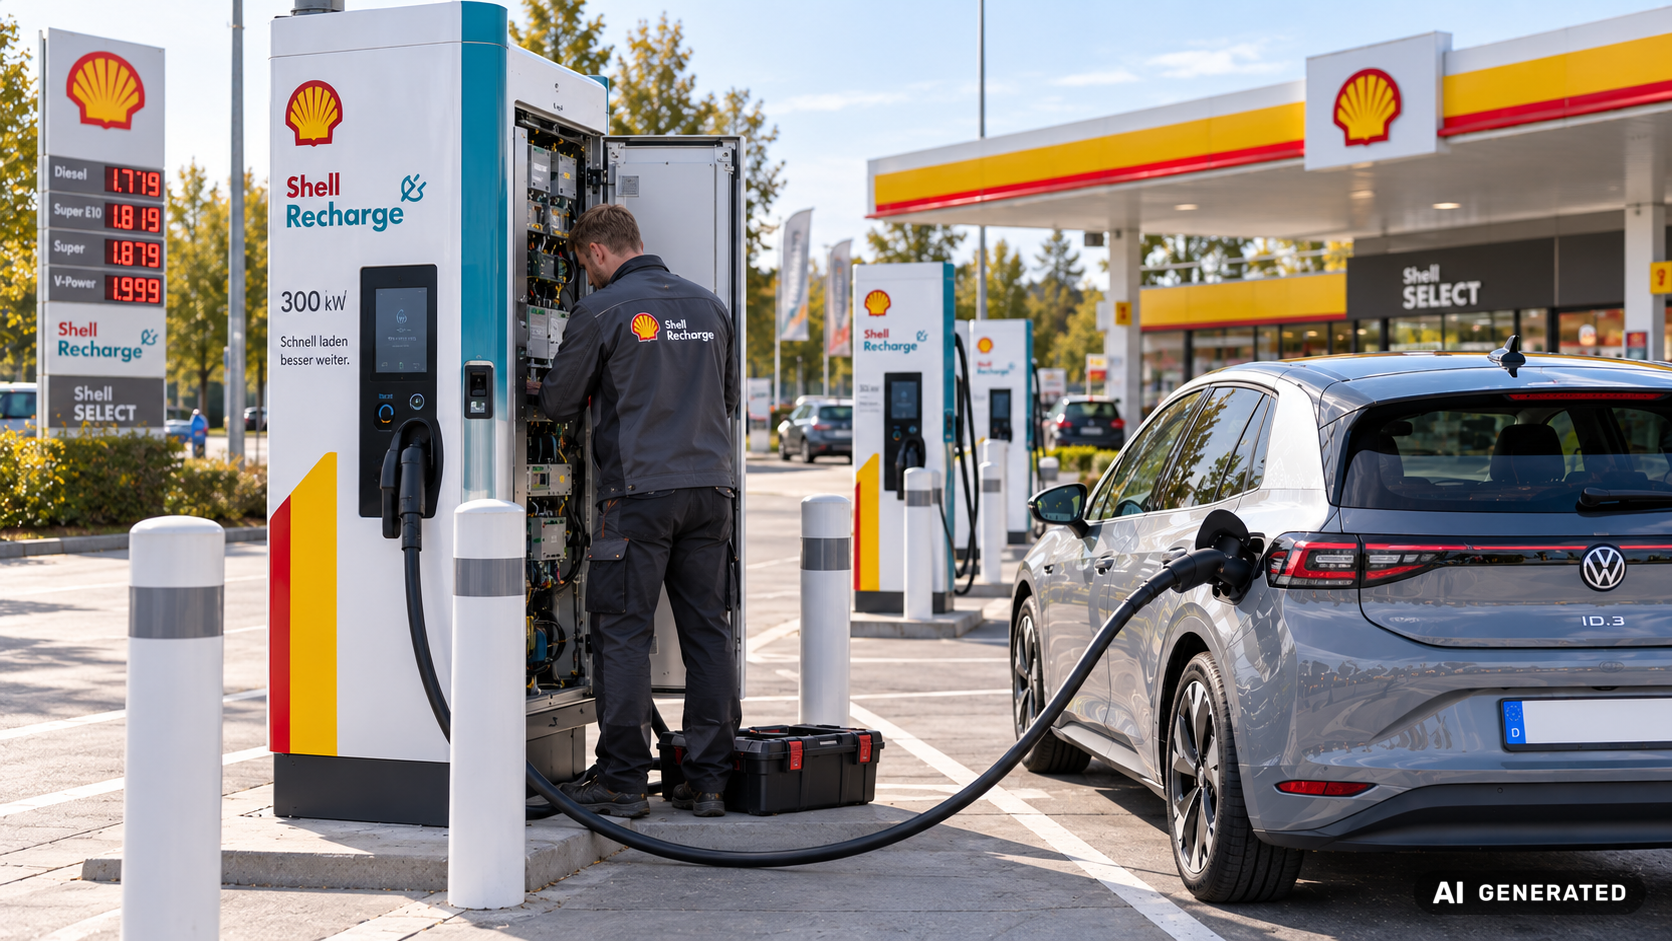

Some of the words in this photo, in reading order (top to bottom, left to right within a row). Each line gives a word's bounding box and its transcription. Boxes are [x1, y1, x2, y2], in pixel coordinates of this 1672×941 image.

[54, 166, 87, 180] Diesel
[286, 172, 340, 198] Shell
[54, 203, 84, 218] Super
[85, 205, 102, 219] E10
[113, 204, 160, 233] 1.819
[286, 201, 404, 232] Recharge
[54, 240, 85, 255] Super
[113, 240, 160, 268] 1.879
[1402, 263, 1440, 285] Shell
[54, 275, 96, 289] V-Power
[113, 276, 160, 304] 1.999
[1402, 280, 1482, 310] SELECT
[280, 290, 321, 313] 300
[324, 290, 347, 311] kW
[58, 322, 98, 337] Shell
[664, 319, 687, 329] Shell
[280, 335, 317, 347] Schnell
[319, 335, 348, 347] laden
[666, 329, 715, 342] Recharge
[864, 328, 890, 339] Shell
[58, 340, 143, 362] Recharge
[864, 340, 918, 354] Recharge
[280, 353, 314, 366] besser
[315, 353, 350, 366] weiter.
[74, 386, 112, 402] Shell
[74, 405, 137, 421] SELECT
[1581, 615, 1626, 627] ID.3
[1511, 727, 1521, 738] D
